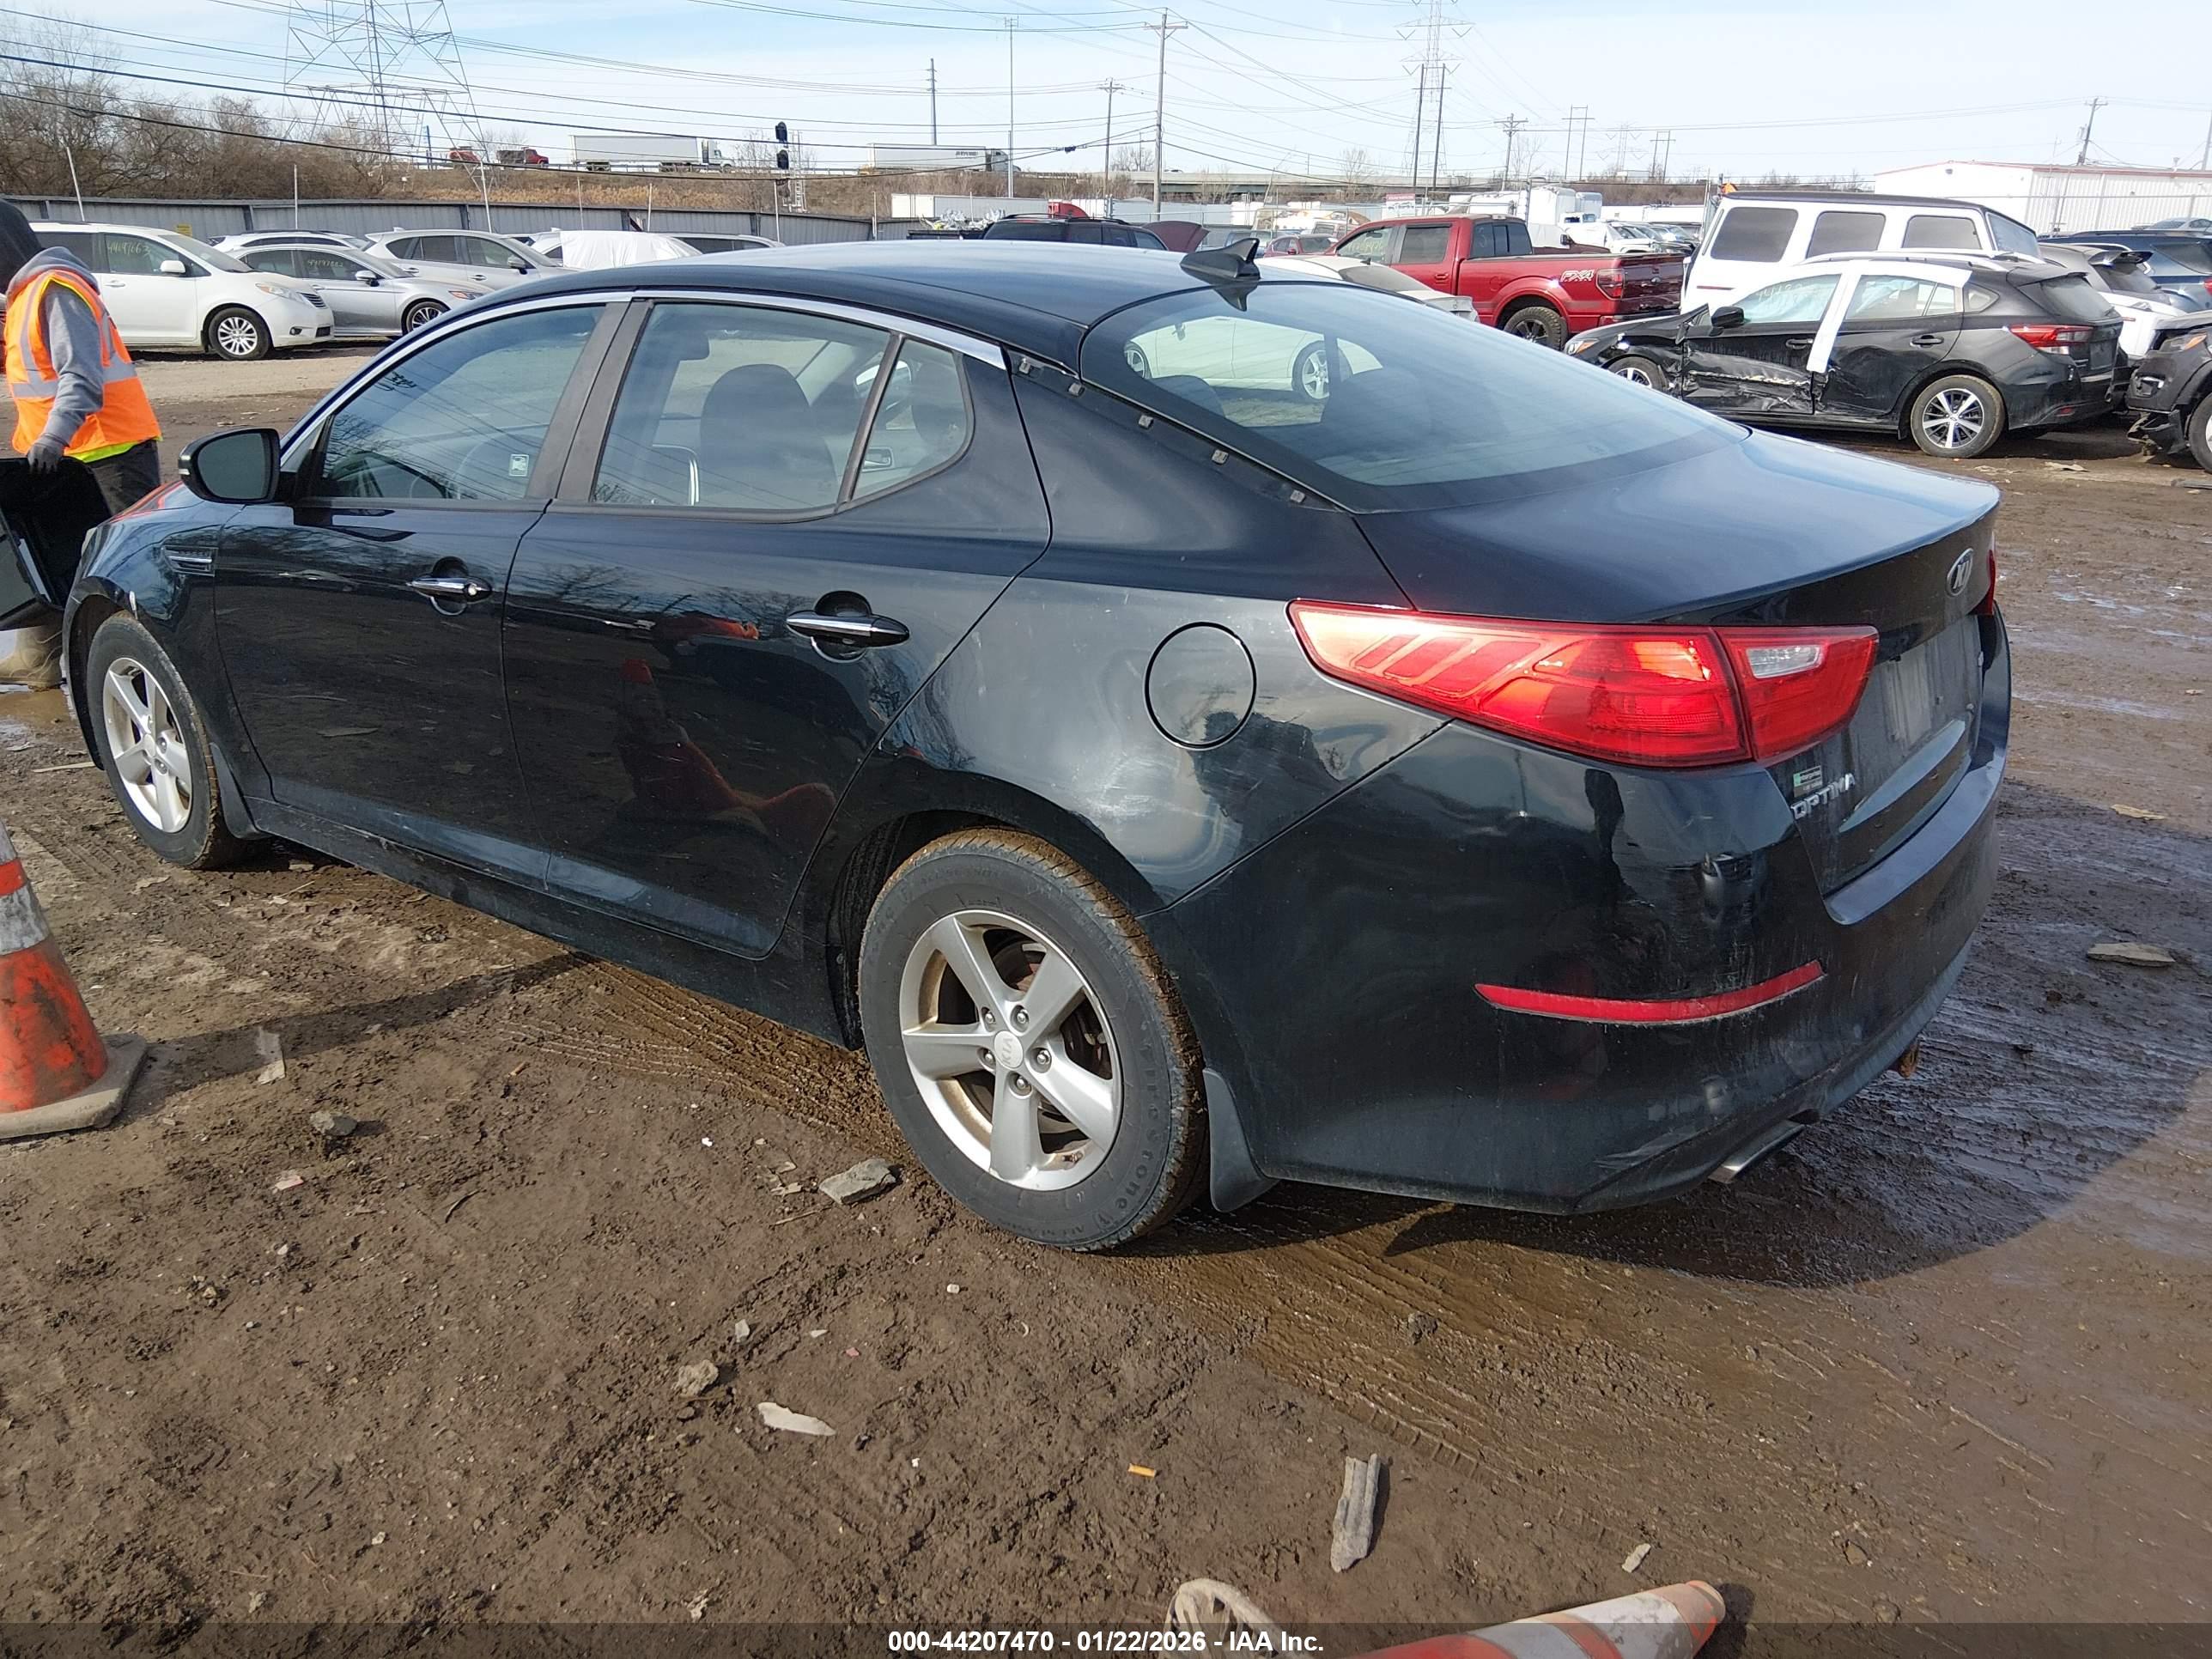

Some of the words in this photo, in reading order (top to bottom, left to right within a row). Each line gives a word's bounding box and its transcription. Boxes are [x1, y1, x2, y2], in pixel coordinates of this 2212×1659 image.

[1559, 270, 1595, 281] FX4
[1790, 773, 1855, 819] OPTIMA
[1002, 1037, 1013, 1065] KIA
